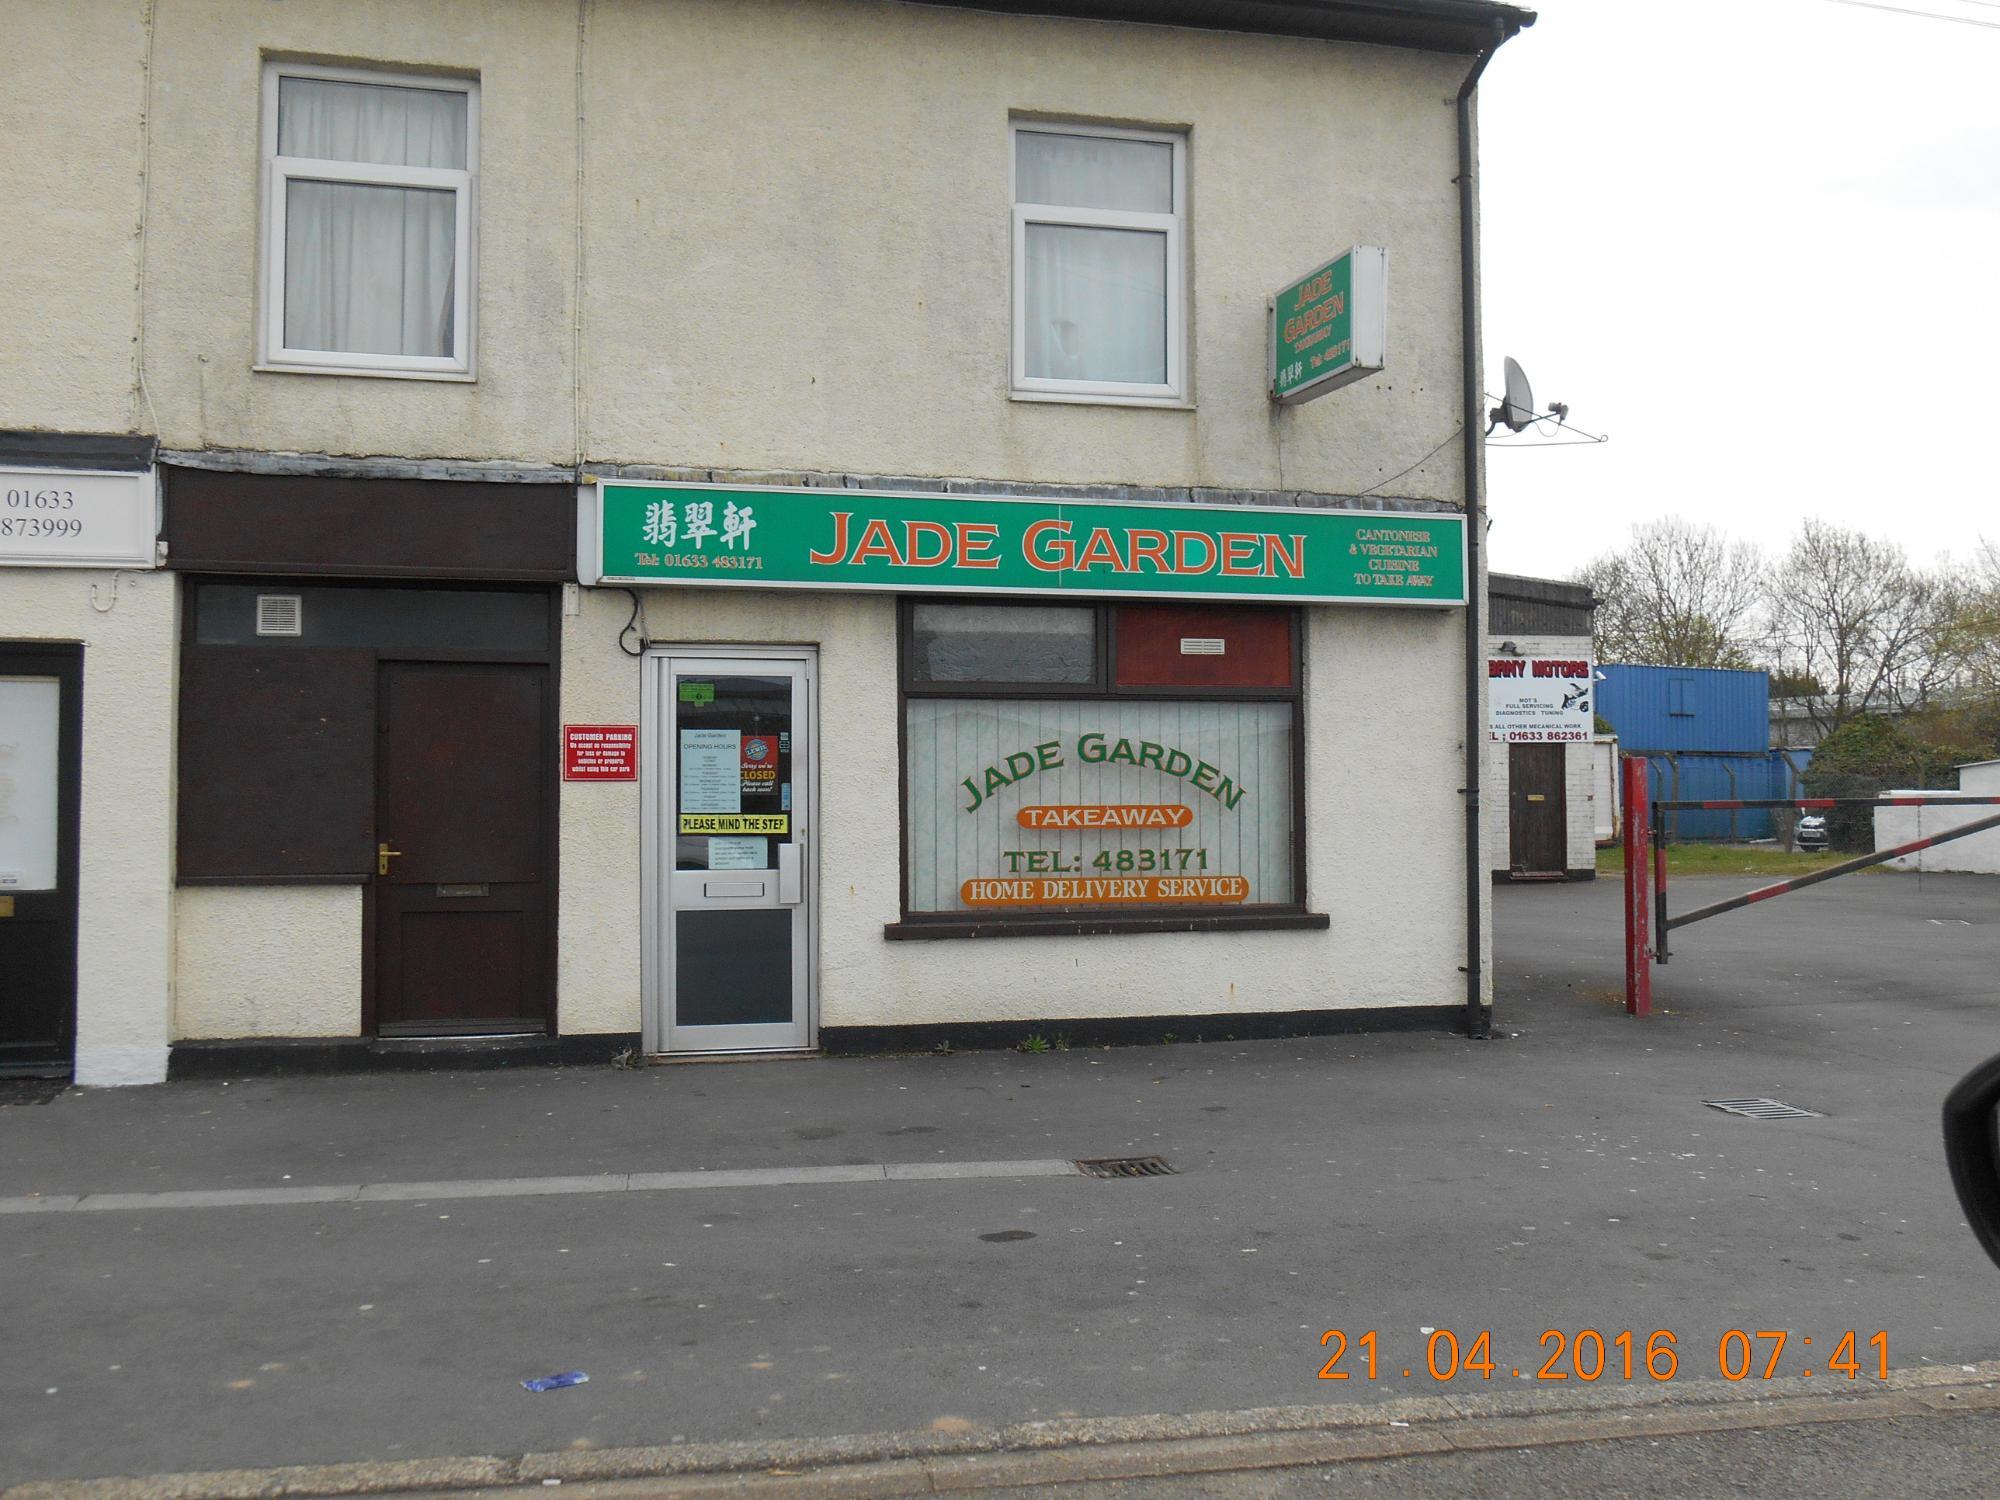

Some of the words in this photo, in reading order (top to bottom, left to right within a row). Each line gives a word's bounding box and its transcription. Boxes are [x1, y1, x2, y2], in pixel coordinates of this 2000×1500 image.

[1294, 270, 1333, 312] JADE
[1283, 290, 1345, 344] GARDEN
[7, 489, 74, 509] 01633
[1, 518, 82, 538] 873999
[642, 499, 757, 550] 翡翠軒
[809, 511, 1002, 569] JADE
[1022, 519, 1308, 579] GARDEN
[1355, 528, 1431, 543] CANTONESE
[1348, 544, 1358, 555] &
[1359, 544, 1439, 558] VEGETARIAN
[664, 553, 708, 569] 01633
[712, 555, 763, 570] 483171
[1368, 559, 1420, 572] CUISINE
[1353, 573, 1372, 585] TO
[1373, 573, 1404, 586] TAKE
[1405, 575, 1435, 587] AWAY
[1531, 660, 1589, 679] MOTORS
[570, 733, 603, 741] CUSTOMER
[606, 733, 632, 741] PARKING
[1509, 731, 1543, 740] 01633
[1547, 731, 1588, 740] 862361
[961, 740, 1065, 813] JADE
[1077, 733, 1246, 811] GARDEN
[683, 818, 716, 830] PLEASE
[718, 818, 741, 830] MIND
[743, 818, 760, 830] THE
[762, 818, 784, 830] STEP
[1024, 808, 1186, 826] TAKEAWAY
[1003, 850, 1081, 873] TEL:
[1091, 847, 1209, 872] 483171
[970, 880, 1034, 900] HOME
[1042, 879, 1149, 900] DELIVERY
[1157, 877, 1243, 898] SERVICE
